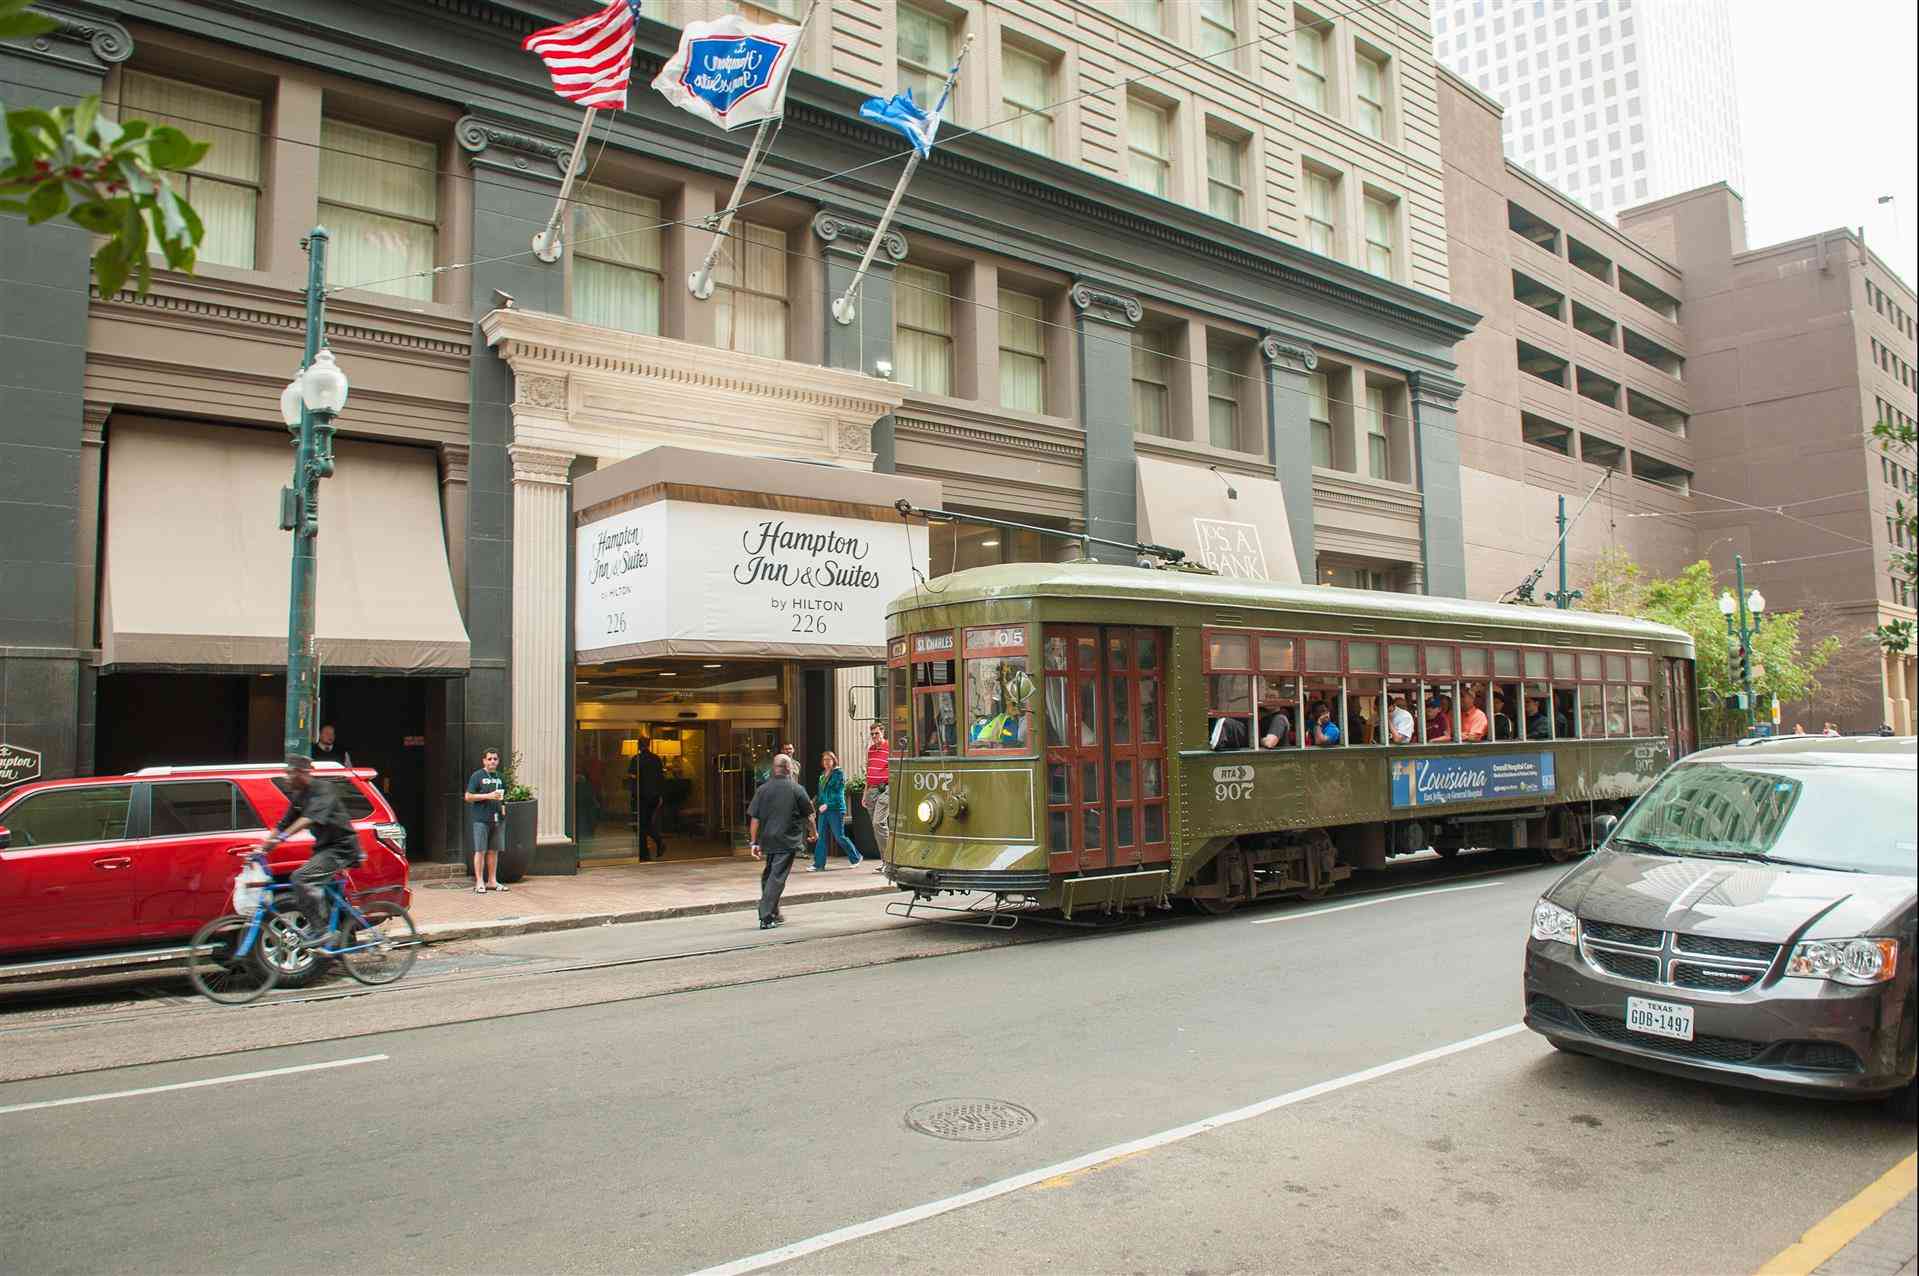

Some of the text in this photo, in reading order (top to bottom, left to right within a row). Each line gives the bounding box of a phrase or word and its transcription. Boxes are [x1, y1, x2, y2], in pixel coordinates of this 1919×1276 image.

[592, 526, 643, 558] Hampton
[743, 521, 869, 559] Hampton
[590, 558, 611, 585] Inn
[619, 550, 648, 574] Suites
[733, 556, 879, 589] Inn & Suites
[1206, 551, 1264, 578] BANK
[771, 597, 843, 611] by HILTON
[607, 612, 626, 634] 226
[792, 613, 827, 633] 226
[927, 635, 954, 651] CHARLES
[914, 772, 953, 791] 907
[1221, 769, 1237, 779] RTA
[1418, 760, 1488, 791] Louisiana
[1215, 782, 1254, 801] 907
[1648, 1003, 1673, 1013] TEXAS
